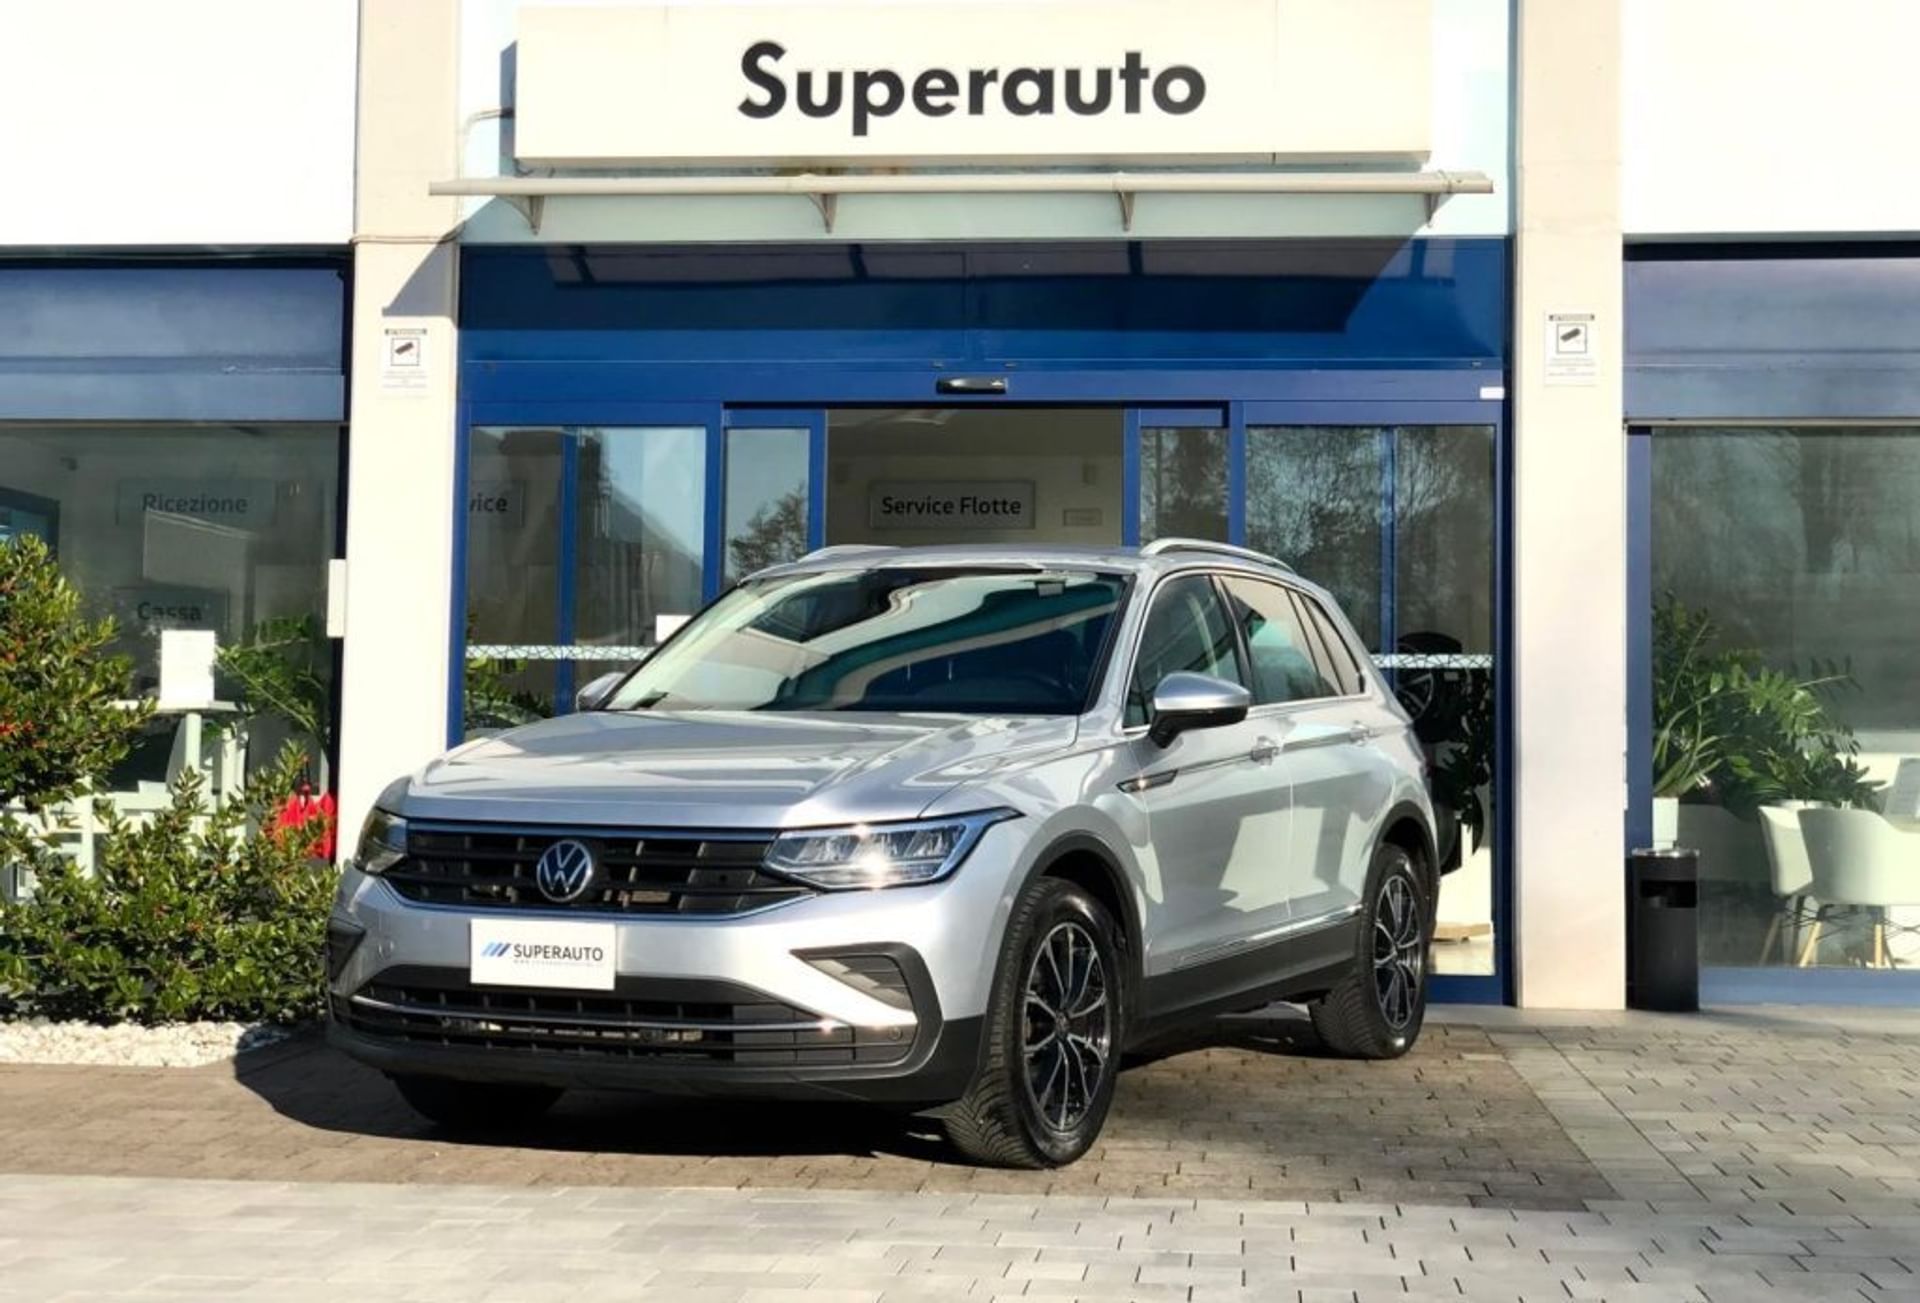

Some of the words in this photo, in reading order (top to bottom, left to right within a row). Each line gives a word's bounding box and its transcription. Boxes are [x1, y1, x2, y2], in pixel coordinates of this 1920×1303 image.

[737, 40, 1207, 137] Superauto
[142, 492, 248, 514] Ricezione
[881, 495, 954, 516] Service
[960, 496, 1022, 516] Flotte
[137, 602, 203, 622] Cassa
[513, 943, 604, 962] SUPERAUTO
